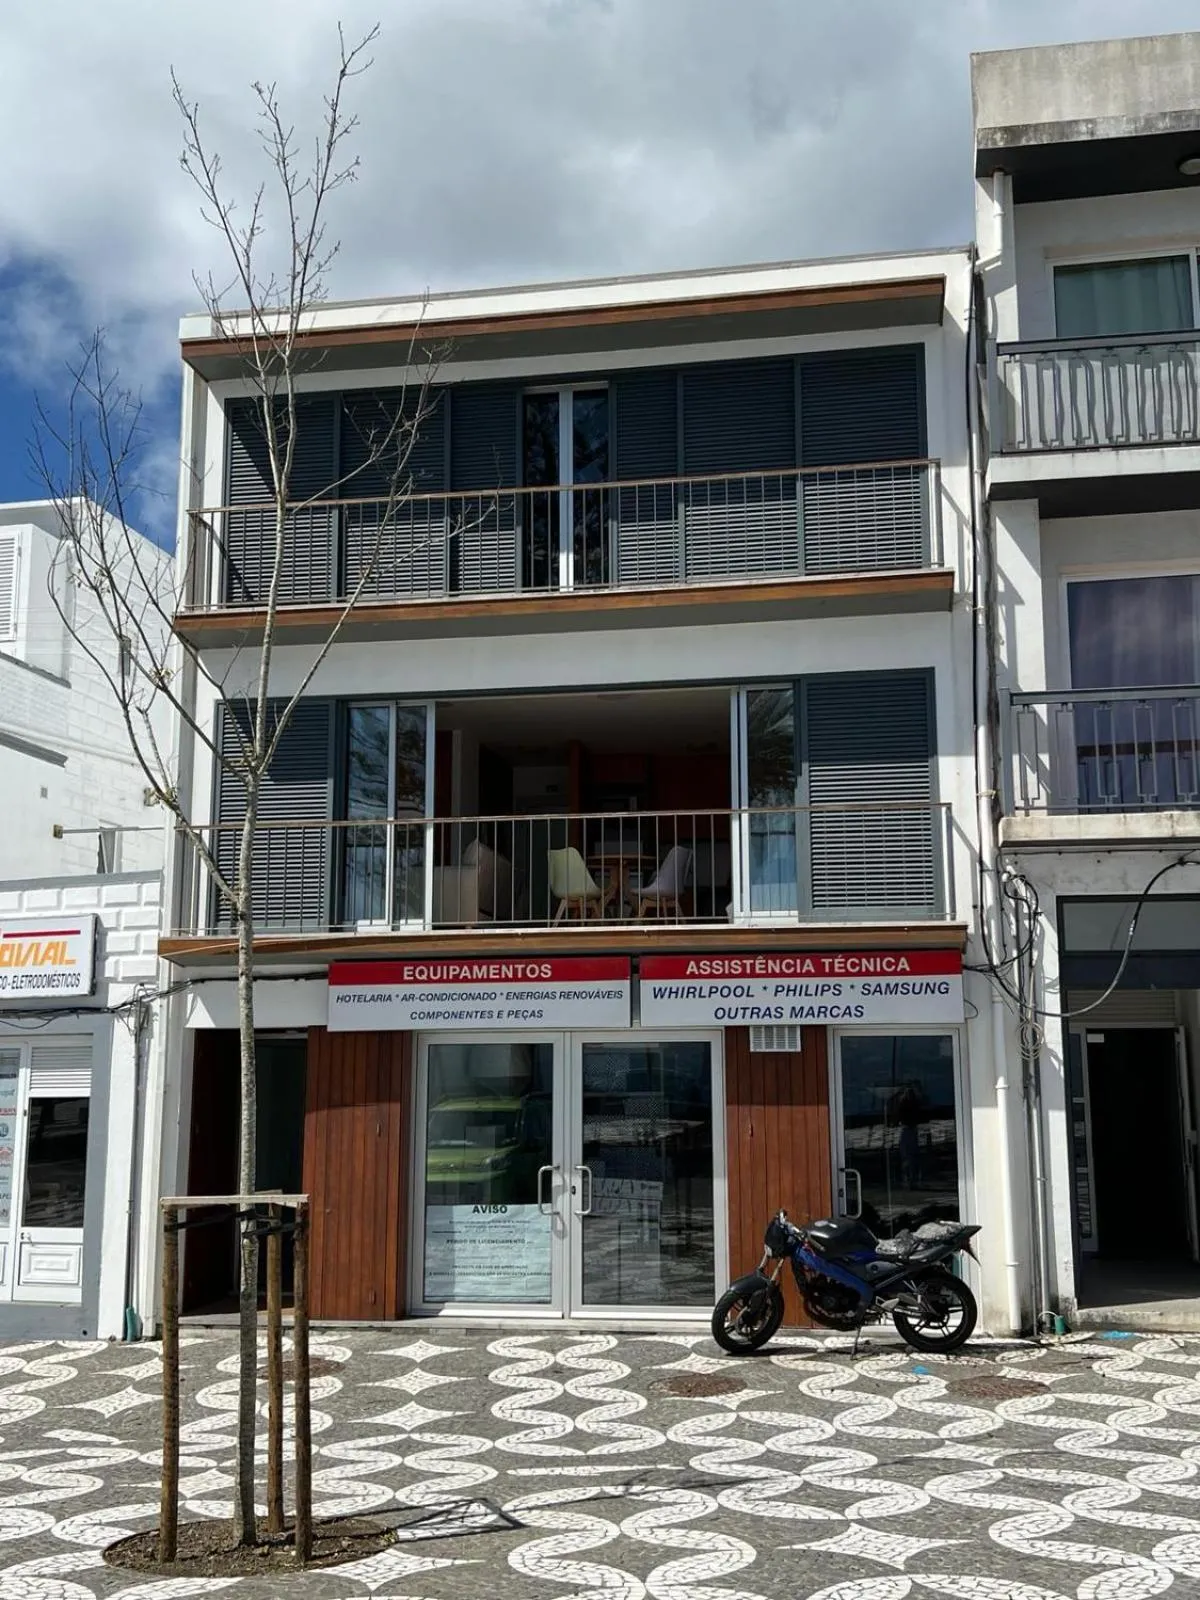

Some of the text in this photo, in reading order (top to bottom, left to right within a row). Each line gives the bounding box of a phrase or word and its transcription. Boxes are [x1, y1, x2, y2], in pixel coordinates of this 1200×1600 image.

[403, 964, 552, 980] EQUIPAMENTOS
[686, 954, 910, 975] ASSISTÊNCIA TÉCNICA
[336, 988, 624, 1003] HOTELARIA AR-CONDICIONADO ENERGIAS RENOVÁVEIS
[653, 981, 951, 999] WHIRLPOOL PHILIPS SAMSUNG
[410, 1009, 544, 1020] COMPONENTES E PEÇAS
[714, 1005, 865, 1020] OUTRAS MARCAS
[472, 1205, 508, 1214] AVISO
